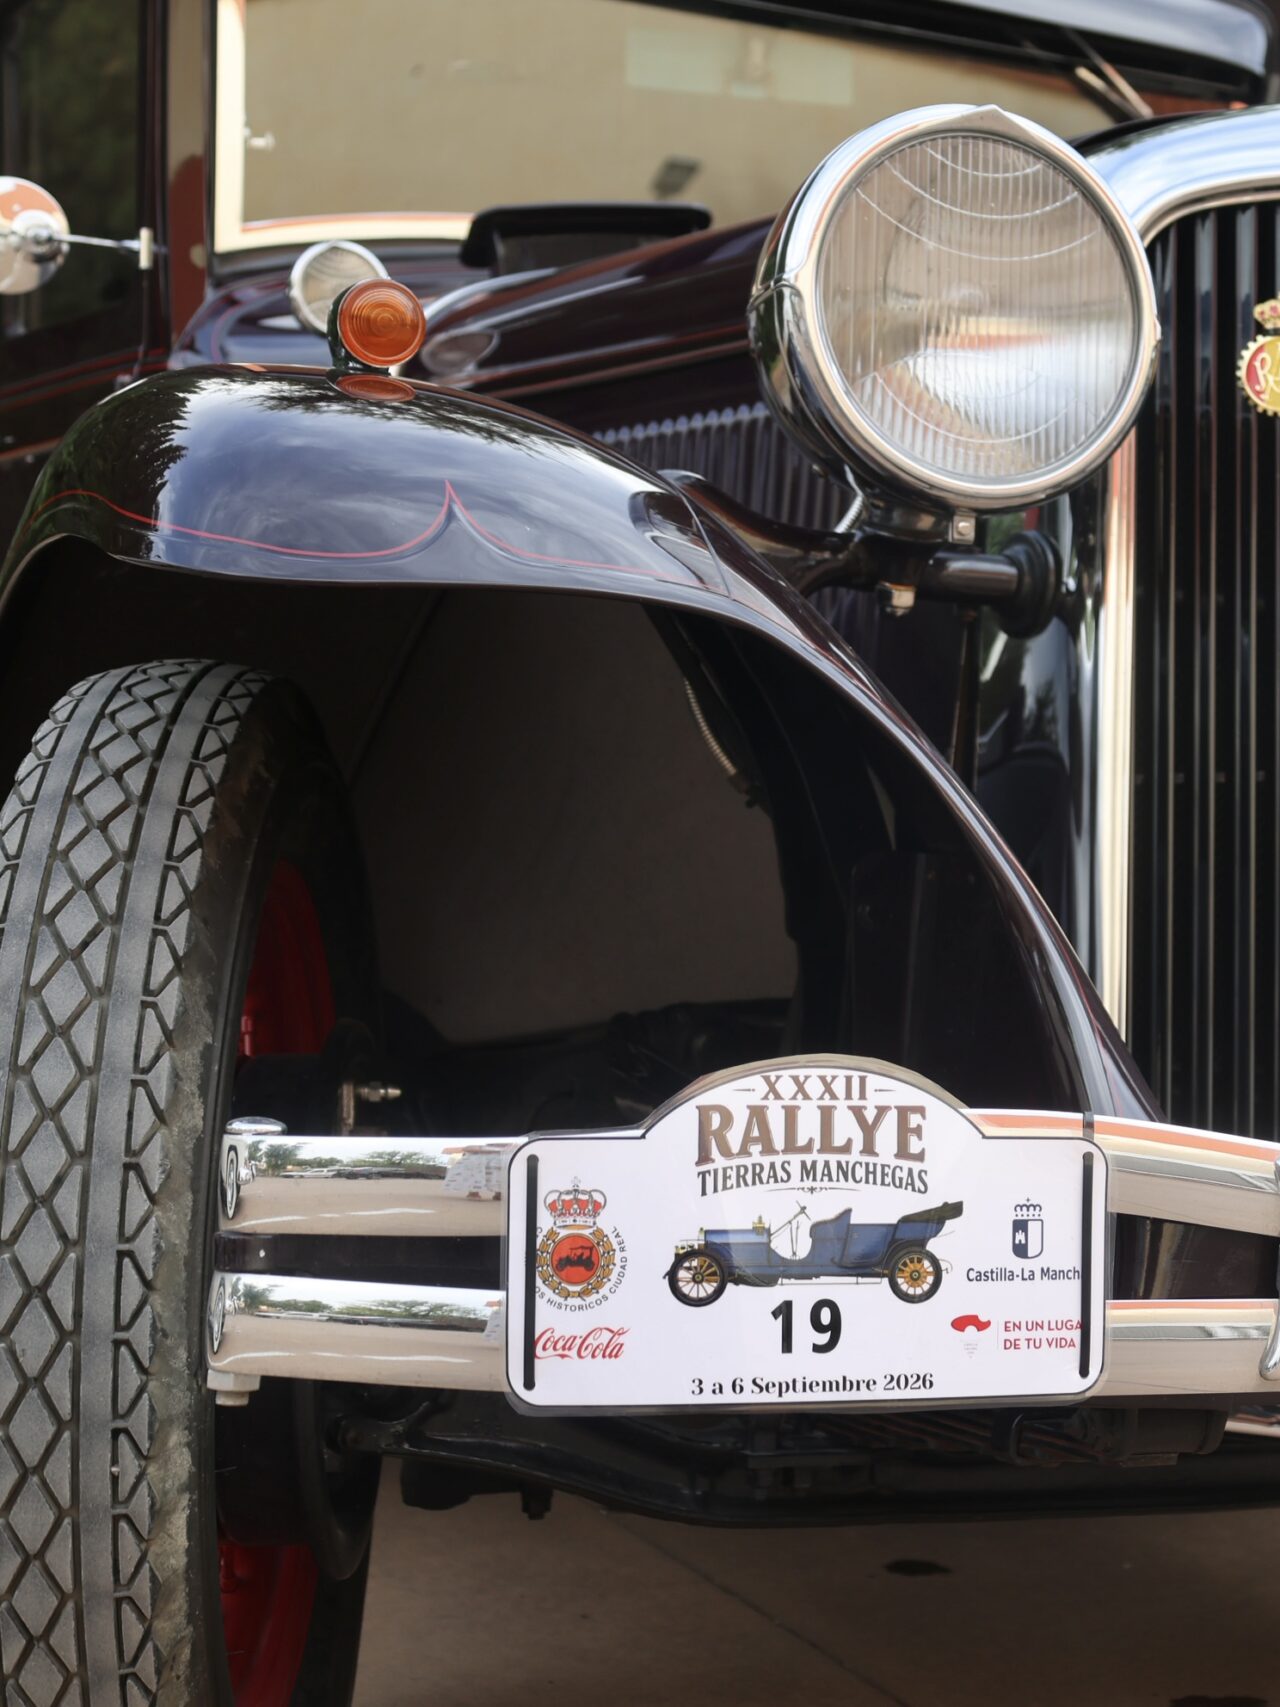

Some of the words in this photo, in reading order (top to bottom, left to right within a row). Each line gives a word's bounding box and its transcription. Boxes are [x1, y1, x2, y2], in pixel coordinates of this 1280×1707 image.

[760, 1074, 869, 1102] XXXII
[695, 1104, 927, 1168] RALLYE
[697, 1159, 792, 1198] TIERRAS
[799, 1159, 929, 1195] MANCHEGAS
[610, 1225, 628, 1253] REAL
[608, 1255, 628, 1295] CIUDAD
[966, 1267, 1036, 1283] Castilla-La
[1040, 1266, 1081, 1281] Manch
[545, 1295, 609, 1312] HISTORICOS
[770, 1298, 843, 1354] 19
[1003, 1320, 1022, 1333] EN
[1025, 1319, 1045, 1332] UN
[1047, 1318, 1083, 1332] LUGA
[534, 1326, 631, 1360] Coca-Cola
[1003, 1338, 1021, 1351] DE
[1024, 1337, 1043, 1350] TU
[1045, 1336, 1076, 1349] VIDA
[691, 1377, 704, 1396] 3
[711, 1381, 724, 1396] a
[731, 1376, 745, 1396] 6
[751, 1374, 878, 1399] Septiembre
[883, 1372, 935, 1391] 2026
